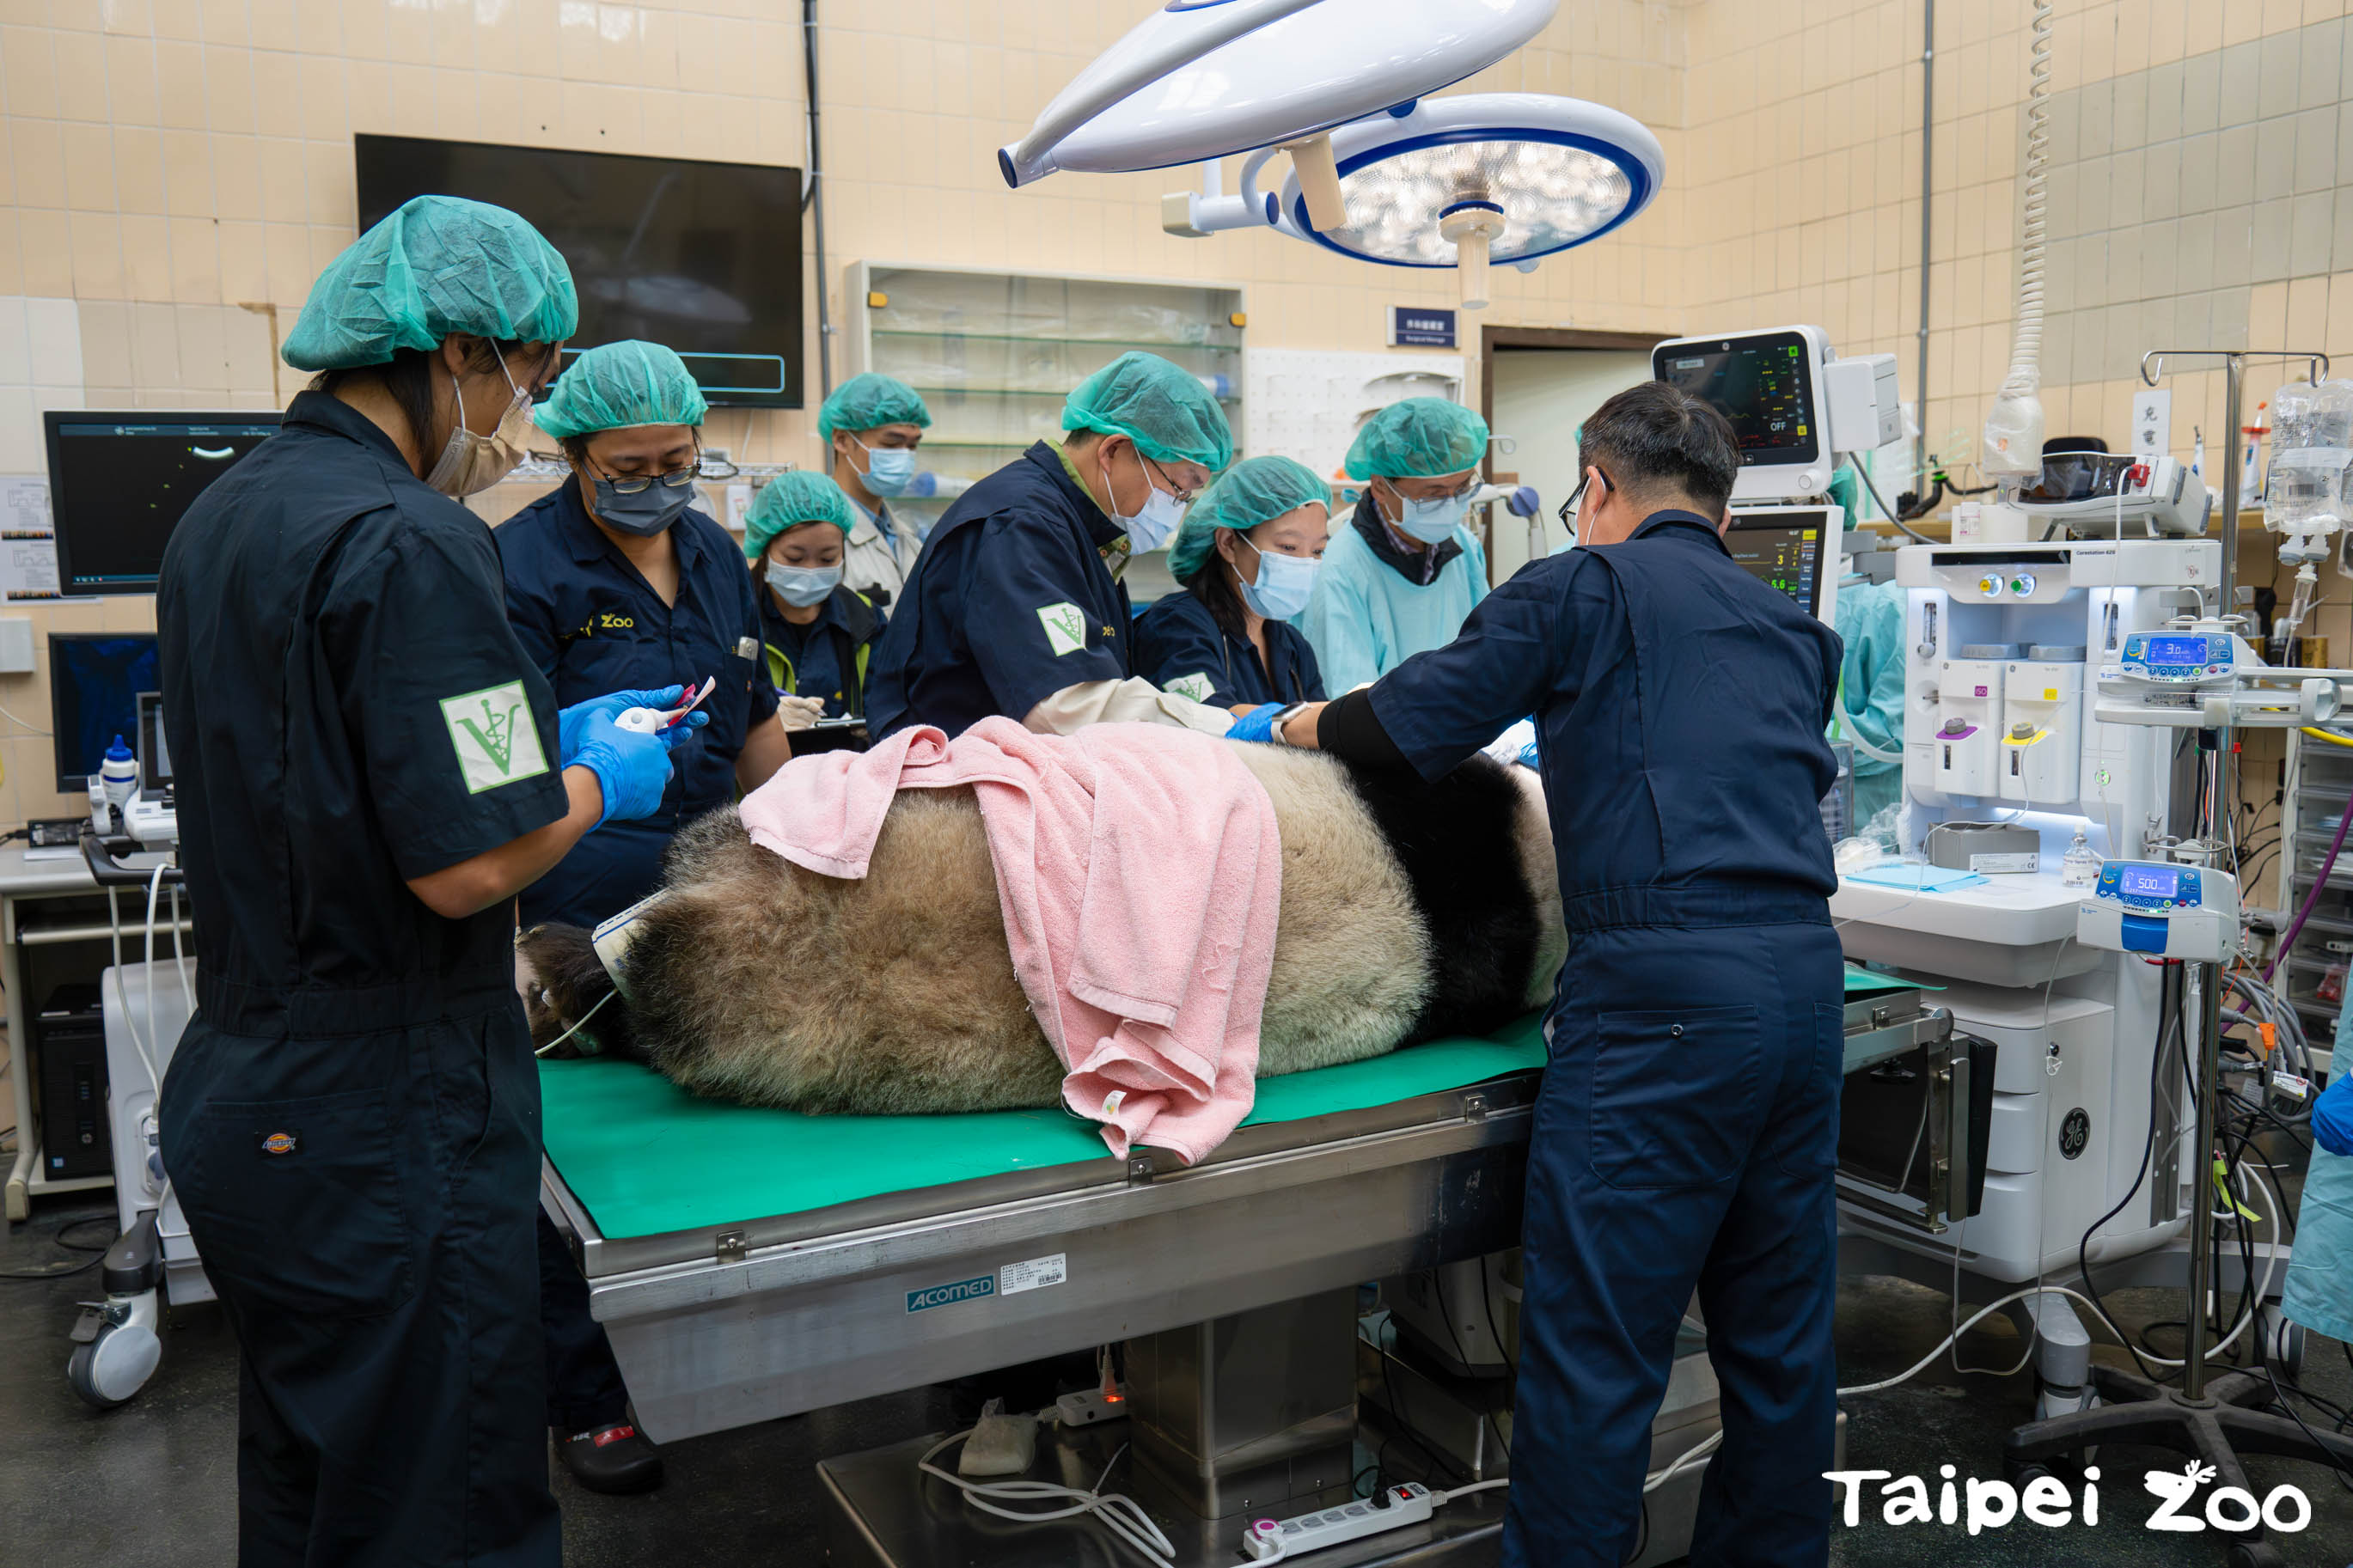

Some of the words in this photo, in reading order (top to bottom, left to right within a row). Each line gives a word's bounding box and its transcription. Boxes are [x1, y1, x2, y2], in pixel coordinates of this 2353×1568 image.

[1770, 422, 1787, 431] OFF
[1777, 554, 1784, 565] 3
[601, 613, 634, 628] Zoo
[2137, 877, 2158, 890] 500
